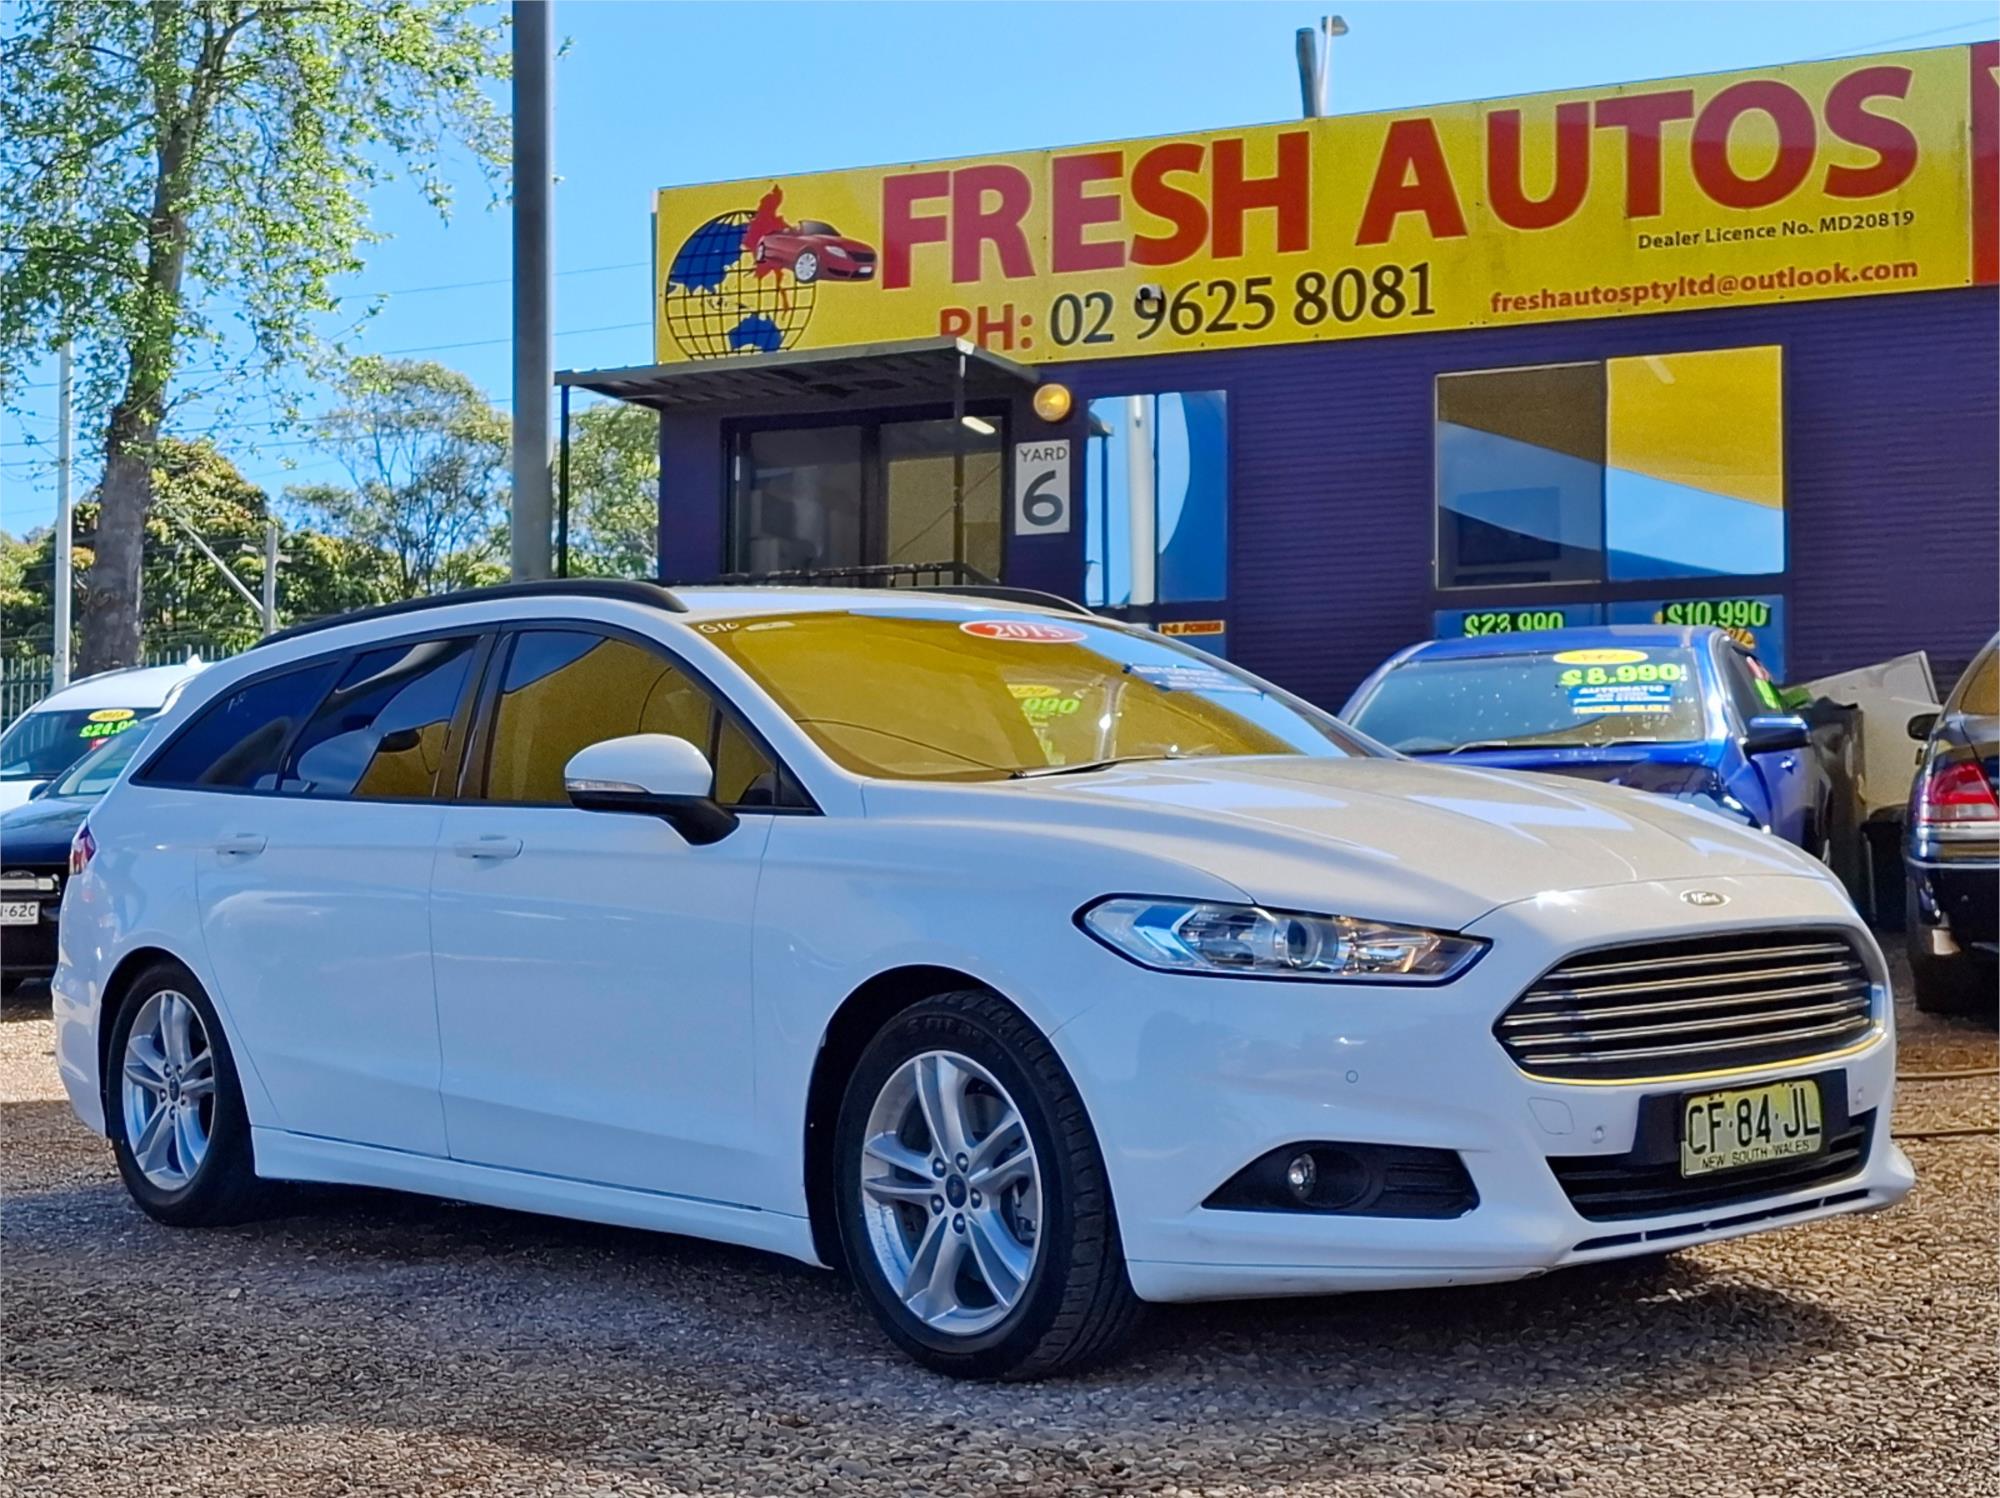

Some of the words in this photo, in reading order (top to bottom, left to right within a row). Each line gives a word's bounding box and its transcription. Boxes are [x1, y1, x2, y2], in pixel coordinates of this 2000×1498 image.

[882, 131, 1310, 290] FRESH
[1355, 66, 1919, 247] AUTOS
[1638, 231, 1701, 249] Dealer
[1705, 225, 1776, 243] Licence
[1782, 220, 1813, 236] No.
[1819, 210, 1914, 233] MD20819
[940, 303, 1033, 351] PH:
[1050, 291, 1115, 347] 02
[1134, 276, 1276, 340] 9625
[1293, 262, 1436, 326] 8081
[1491, 261, 1918, 313] freshautosptyltd@outlook.com
[1020, 446, 1067, 462] YARD
[1022, 469, 1063, 527] 6
[1732, 1147, 1768, 1166] SOUTH
[1772, 1139, 1810, 1156] WALES
